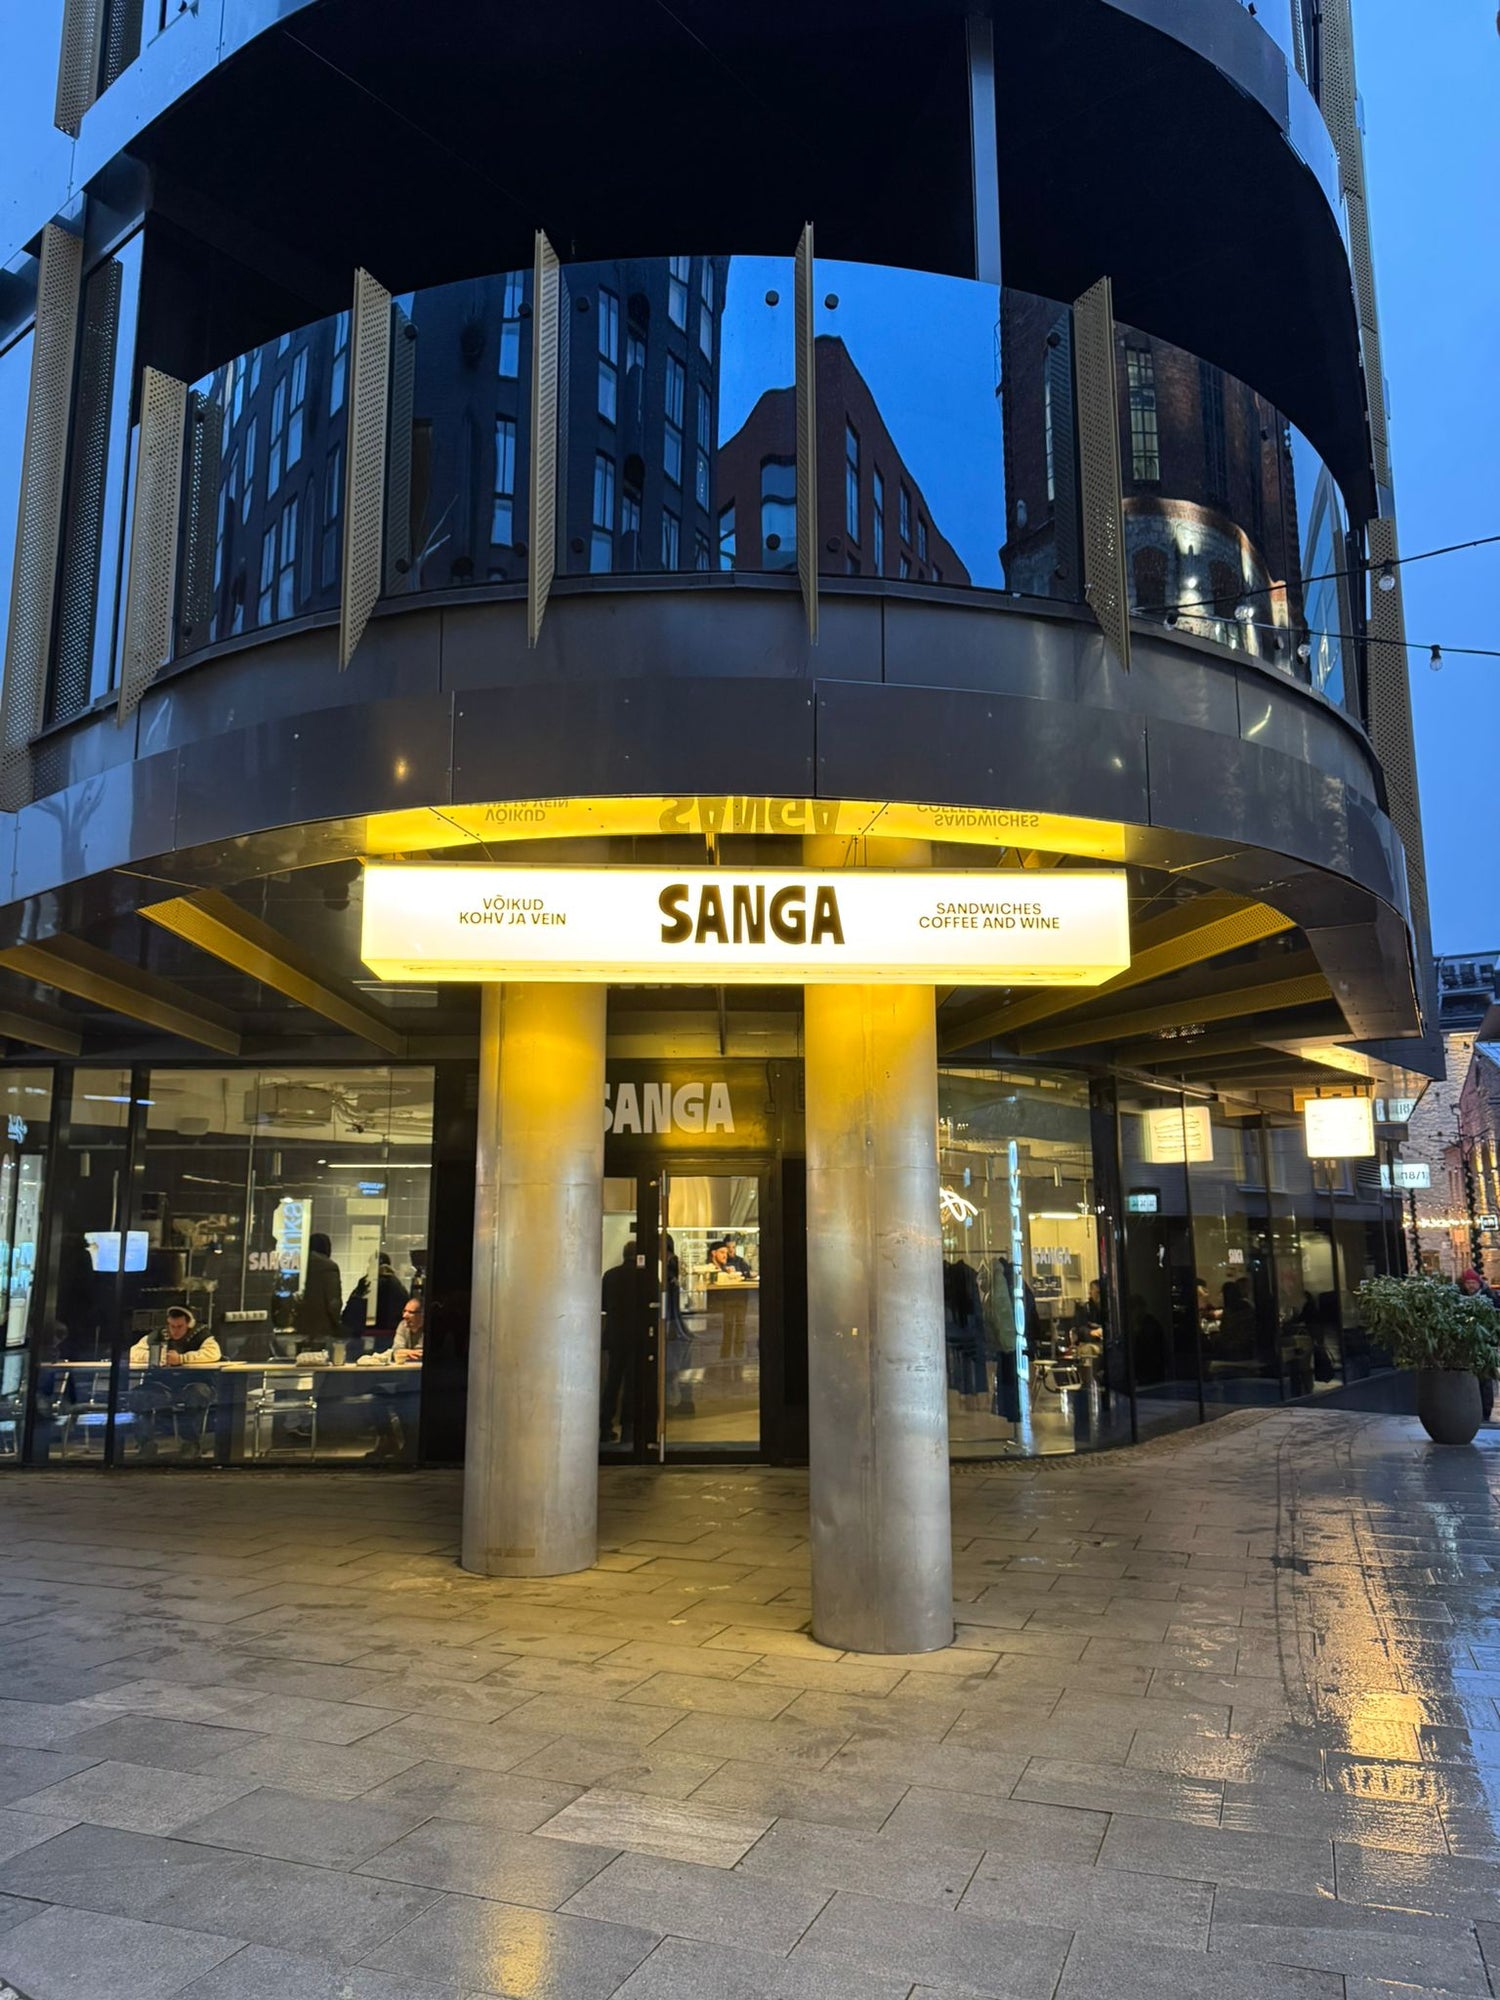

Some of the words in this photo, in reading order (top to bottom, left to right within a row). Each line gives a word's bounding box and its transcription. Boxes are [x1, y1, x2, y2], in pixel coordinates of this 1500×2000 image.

[482, 894, 544, 911] VÕIKUD
[936, 902, 1042, 915] SANDWICHES
[459, 911, 504, 925] KOHV
[508, 912, 526, 925] JA
[531, 912, 567, 926] VEIN
[658, 883, 846, 945] SANGA
[919, 916, 979, 930] COFFEE
[983, 916, 1016, 930] AND
[1020, 916, 1061, 930] WINE
